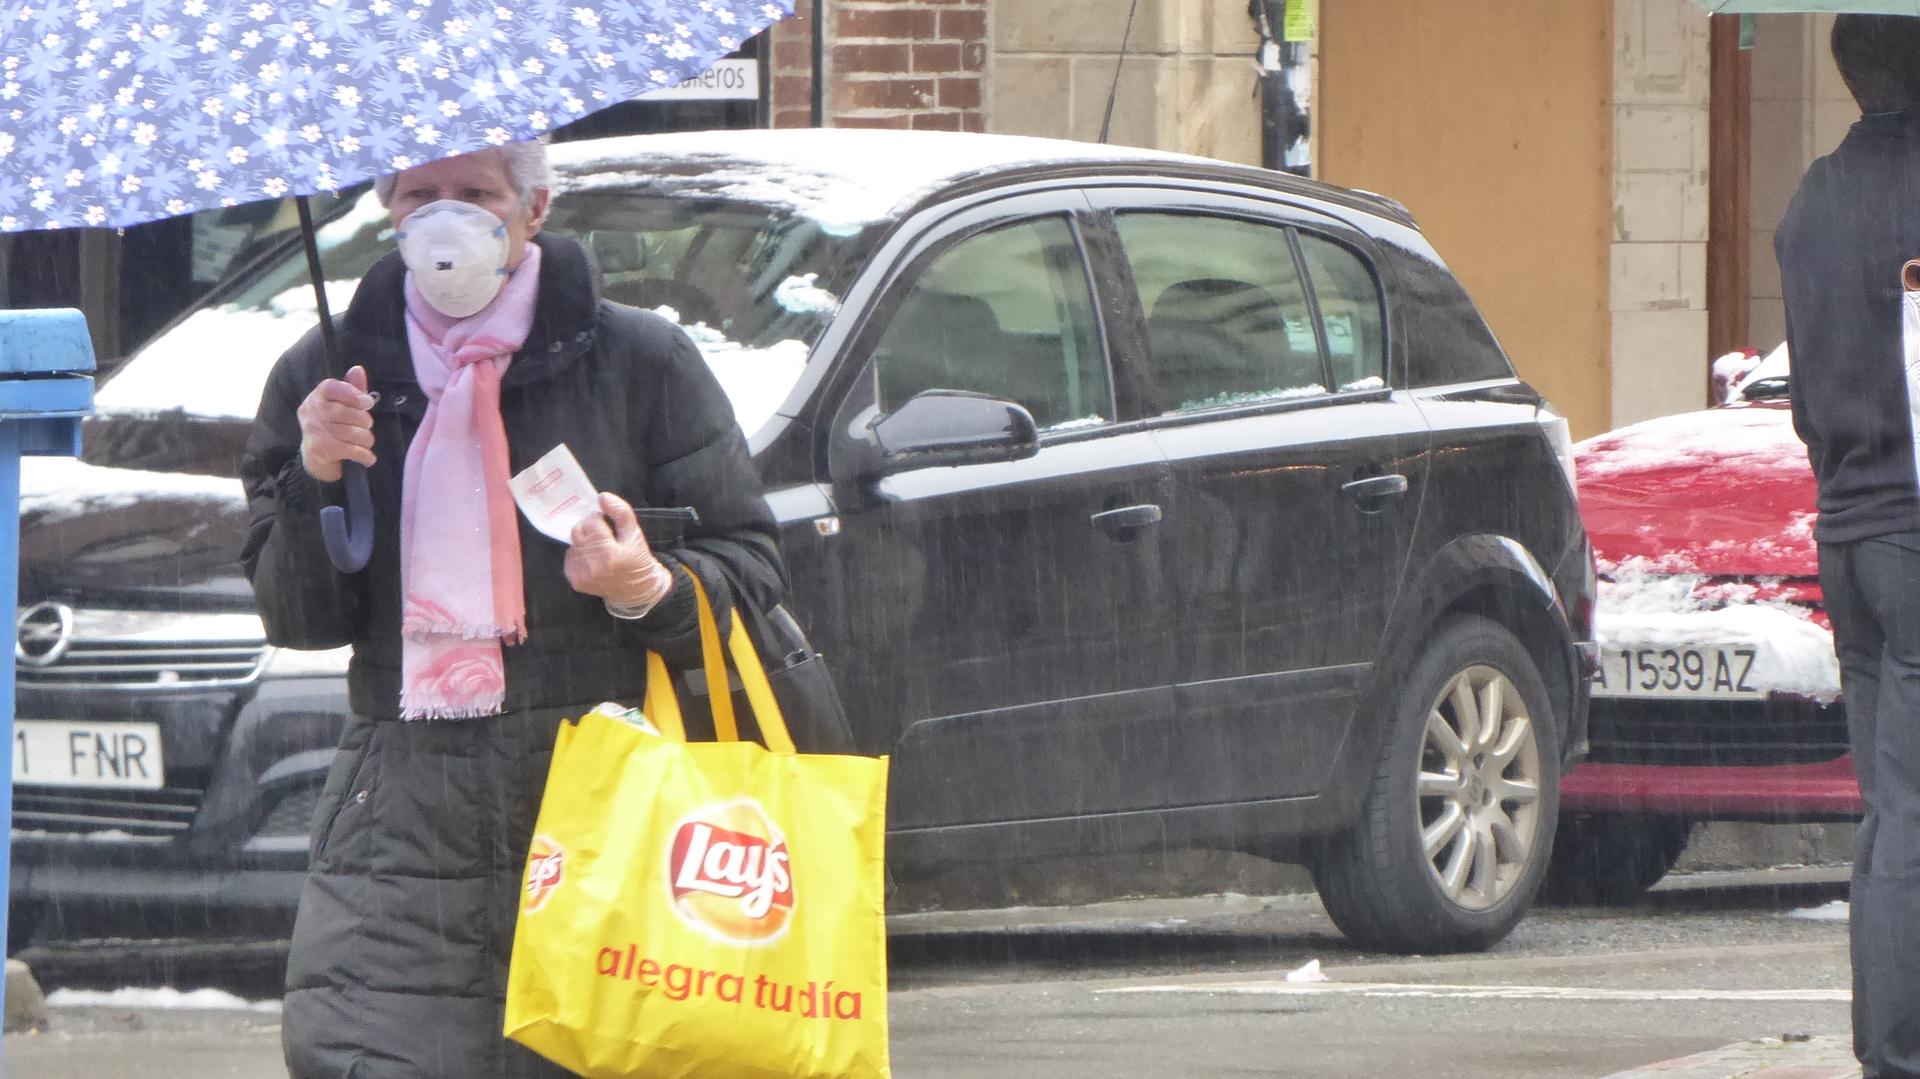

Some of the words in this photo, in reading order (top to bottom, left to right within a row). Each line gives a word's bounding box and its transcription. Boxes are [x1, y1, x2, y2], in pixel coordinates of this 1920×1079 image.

[1621, 649, 1704, 692] 1539
[1713, 649, 1758, 692] AZ
[69, 730, 149, 778] FNR
[596, 943, 745, 1002] alegra
[754, 974, 793, 1012] tu
[799, 980, 862, 1020] día
